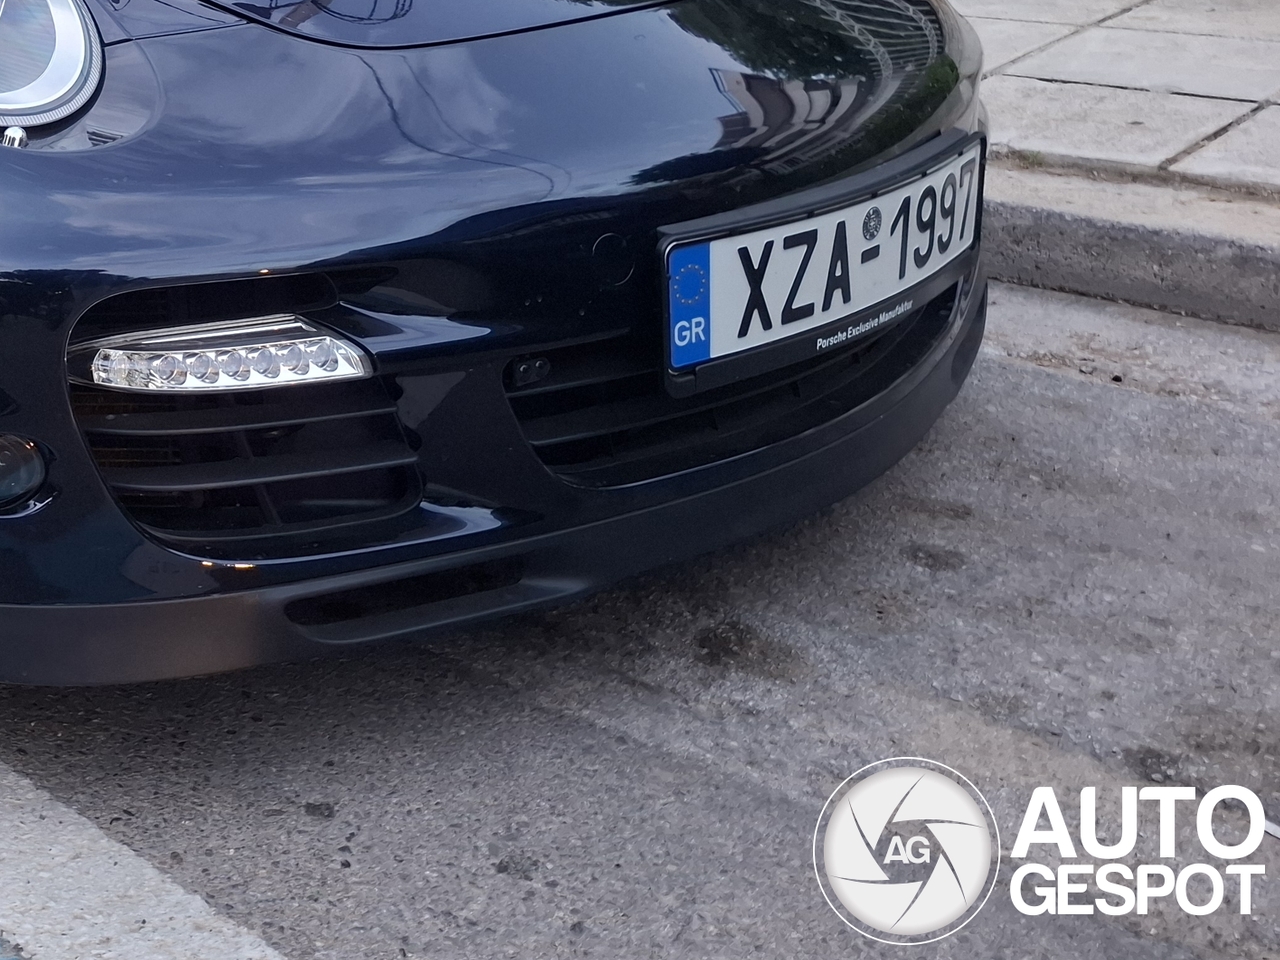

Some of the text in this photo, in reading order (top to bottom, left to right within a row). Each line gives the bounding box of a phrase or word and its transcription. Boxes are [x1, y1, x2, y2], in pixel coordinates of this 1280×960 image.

[737, 155, 977, 339] XZA-1997
[673, 316, 705, 348] GR
[816, 299, 914, 351] Porsche Exclusive Manufaktur
